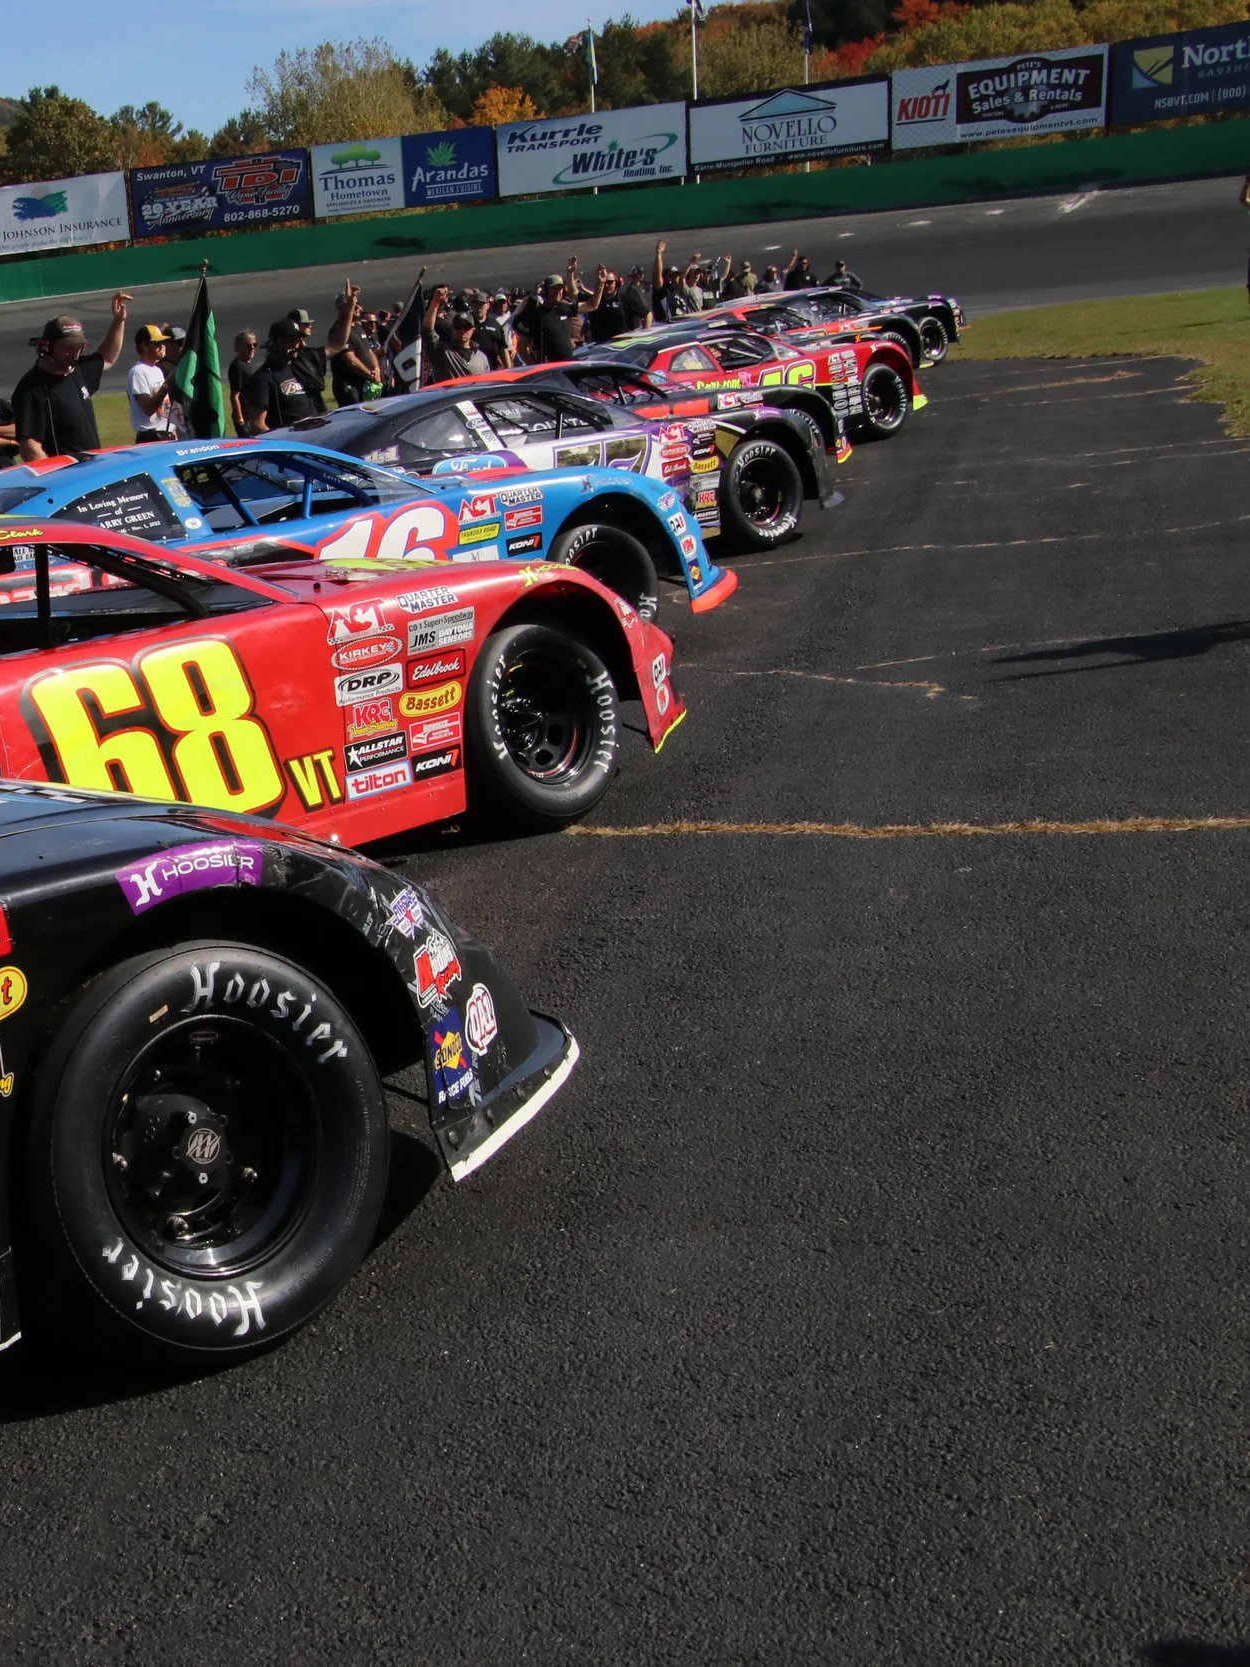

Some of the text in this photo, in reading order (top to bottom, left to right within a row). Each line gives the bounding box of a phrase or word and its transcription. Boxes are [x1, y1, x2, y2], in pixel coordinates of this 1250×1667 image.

[1182, 35, 1250, 68] Nort
[1017, 61, 1042, 70] PETE'S
[967, 68, 1091, 99] EQUIPMENT
[896, 93, 950, 121] KIOTI
[972, 87, 1083, 114] Sales & Rentals
[1154, 84, 1246, 109] NSBVT.COM (800)
[507, 123, 603, 145] Kurrle
[742, 115, 837, 144] NOVELLO
[960, 118, 1098, 139] www.petesequipmentvt.com
[507, 135, 602, 153] TRANSPORT
[745, 134, 828, 154] FURNITURE
[572, 147, 658, 174] White's
[694, 142, 885, 172] Barre-Montpelier Road www.novellofurniture.com
[136, 165, 206, 182] Swanton, VT
[411, 162, 489, 192] Arandas
[623, 164, 675, 178] Heating, Inc.
[319, 173, 395, 191] Thomas
[426, 183, 482, 196] MEXICAN CUISINE
[164, 196, 219, 212] YEAR
[330, 188, 388, 201] Hometown
[150, 206, 215, 230] Anniversary
[224, 205, 300, 222] 802-868-5270
[3, 226, 56, 242] JOHNSON
[59, 217, 123, 233] INSURANCE
[176, 443, 220, 456] Brandon
[693, 459, 716, 470] Bassett
[77, 492, 149, 513] In Loving Memory
[501, 488, 538, 502] QUARTER
[510, 492, 542, 505] MASTER
[115, 507, 122, 515] of
[459, 493, 498, 522] ACT
[99, 511, 155, 529] ARRY GREEN
[483, 525, 497, 534] ROAD
[319, 507, 446, 561] 16
[509, 538, 534, 551] KONI
[565, 526, 598, 565] oosier
[398, 586, 450, 607] QUARTER
[411, 594, 457, 612] MASTER
[327, 598, 387, 644] ACT
[438, 623, 473, 638] DAYTONA
[410, 631, 436, 648] JMS
[438, 632, 473, 646] SENSORS
[339, 643, 388, 660] KIRKEY
[412, 658, 460, 681] Edelbrock
[346, 671, 389, 692] DRP
[339, 686, 401, 704] Performance Products
[406, 686, 456, 711] Bassett
[354, 699, 393, 728] KRC
[586, 670, 620, 774] Hoosier
[31, 640, 341, 814] 68 VT
[358, 736, 404, 754] ALLSTAR
[359, 746, 405, 763] PERFORMANCE
[415, 754, 452, 773] KONI
[351, 768, 407, 795] tilton
[162, 853, 255, 880] HOOSIER
[181, 960, 348, 1064] Hoosier
[102, 1238, 267, 1337] Hoosier
